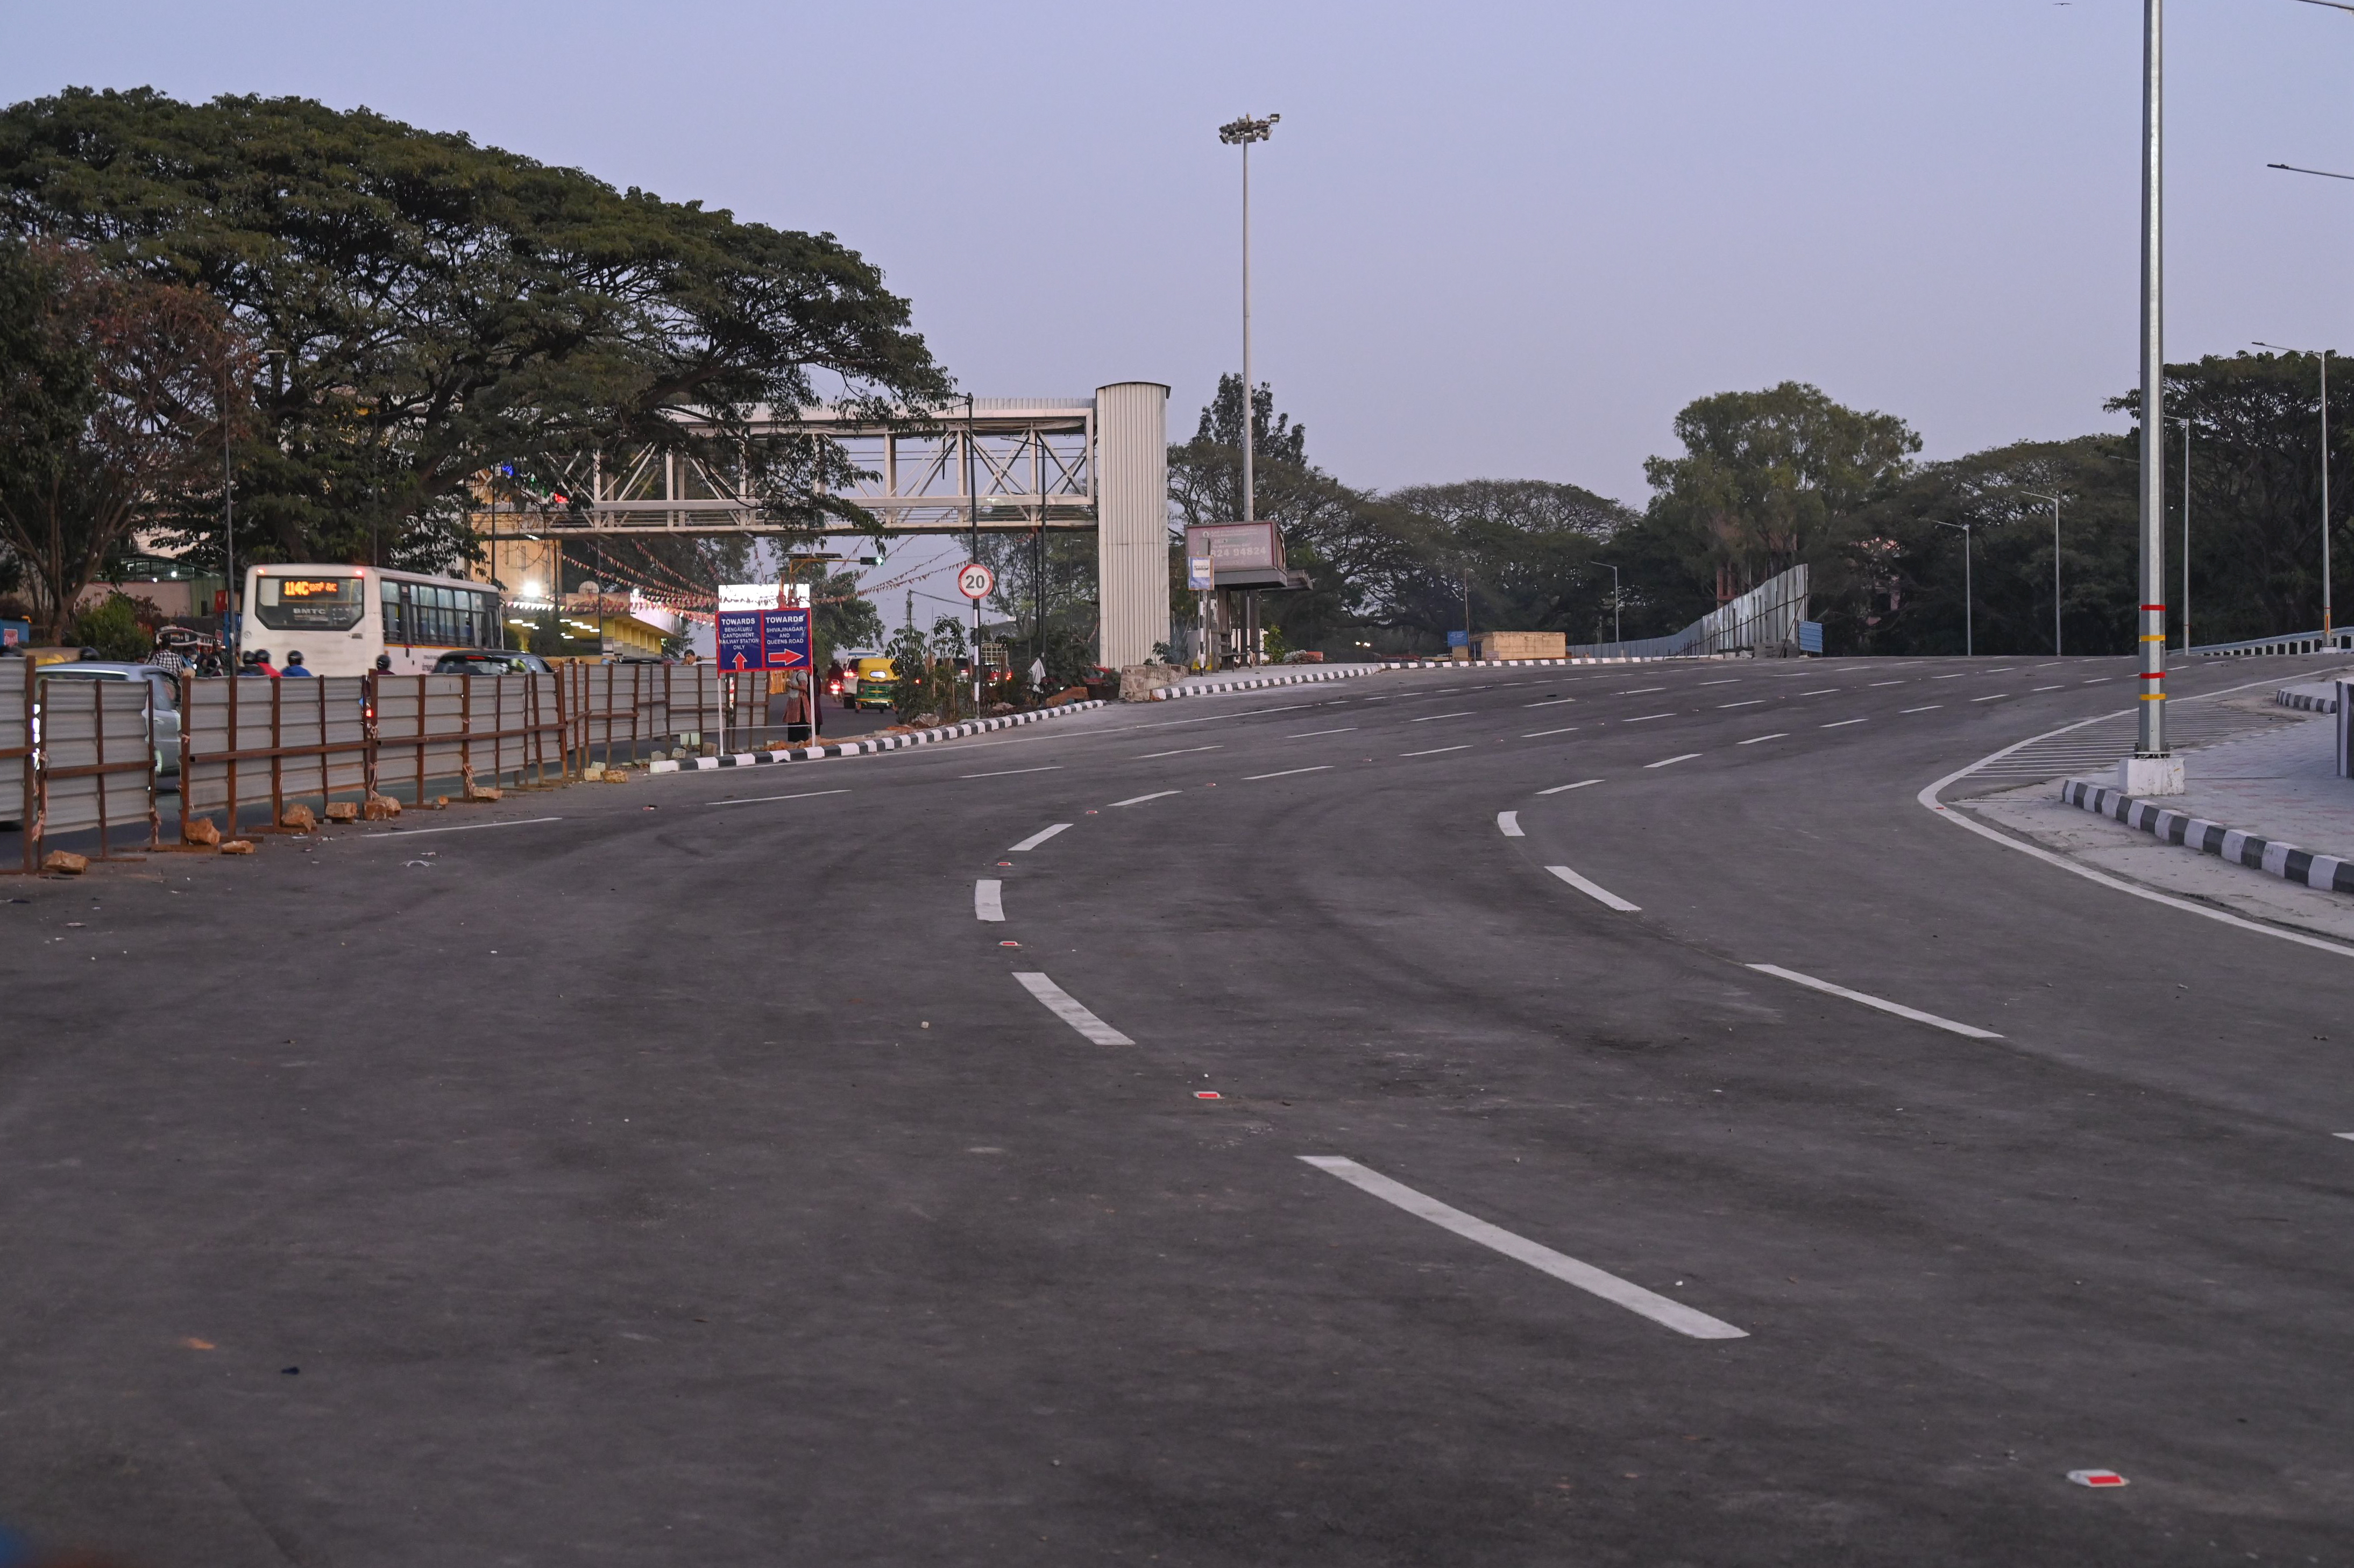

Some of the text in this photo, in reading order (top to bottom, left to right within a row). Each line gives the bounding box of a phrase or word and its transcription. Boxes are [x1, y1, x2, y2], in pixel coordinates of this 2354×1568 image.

[1233, 547, 1266, 556] 94824
[966, 574, 985, 589] 20
[285, 581, 309, 595] 114C
[721, 618, 755, 626] TOWARDS
[765, 615, 804, 624] TOWARDS
